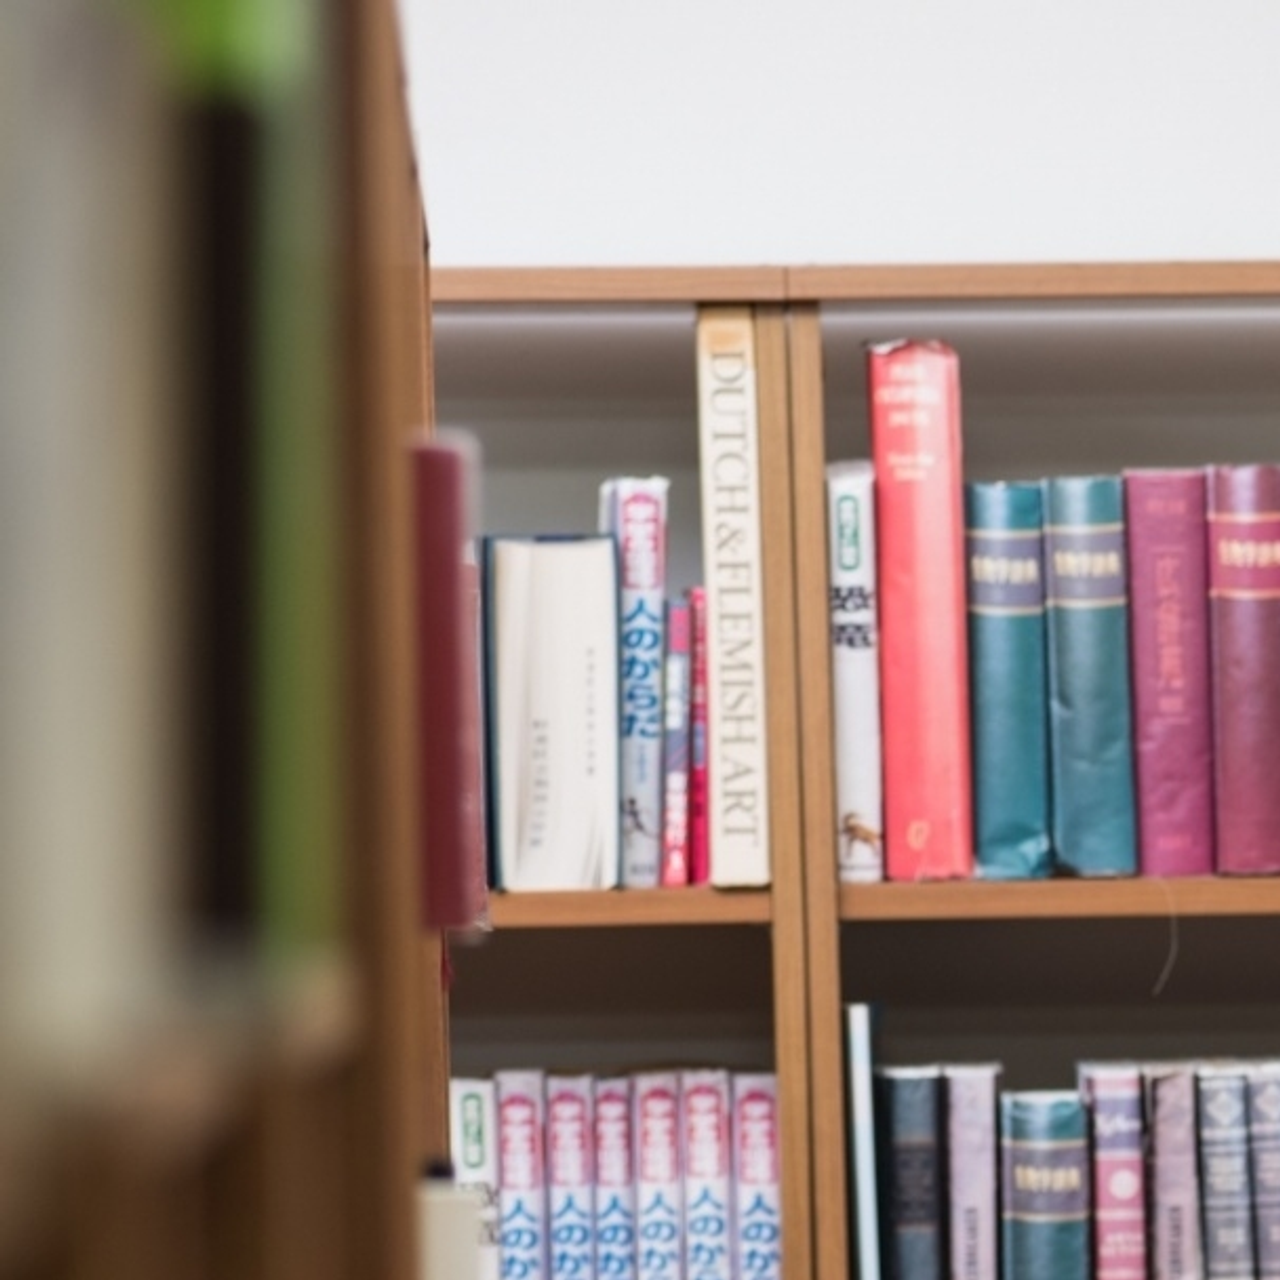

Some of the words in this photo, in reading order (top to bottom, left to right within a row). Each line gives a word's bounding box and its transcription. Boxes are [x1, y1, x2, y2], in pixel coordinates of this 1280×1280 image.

[710, 350, 749, 511] DUTCH
[715, 521, 748, 550] &
[621, 597, 661, 739] 人のからだ
[715, 560, 757, 746] FLEMISH
[720, 757, 759, 847] ART
